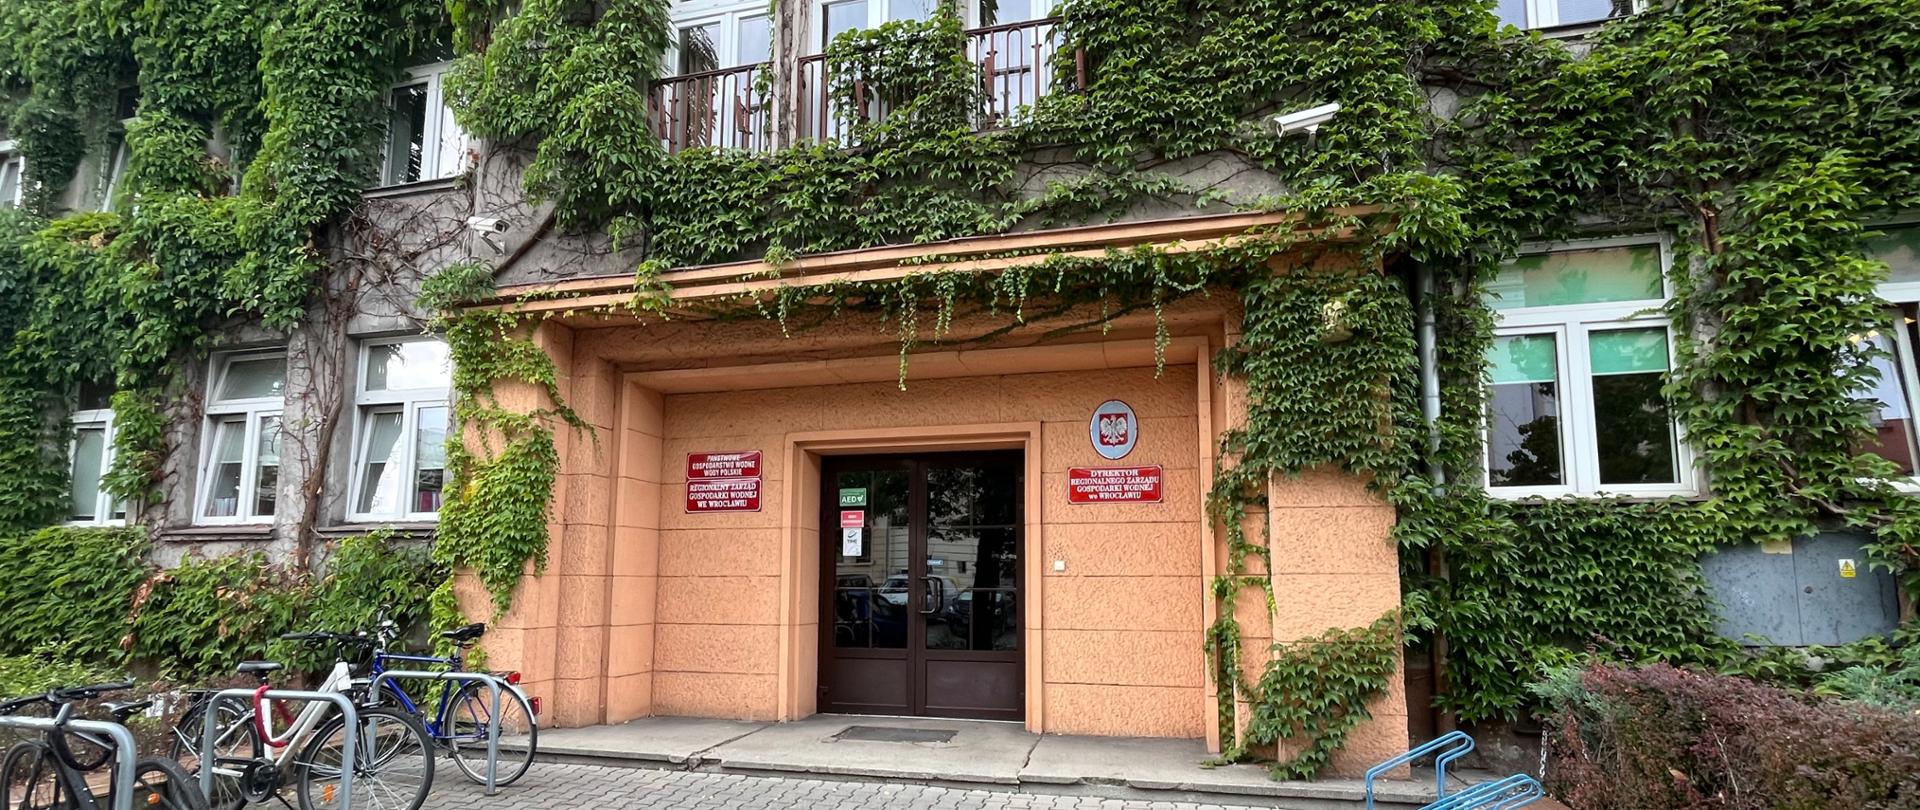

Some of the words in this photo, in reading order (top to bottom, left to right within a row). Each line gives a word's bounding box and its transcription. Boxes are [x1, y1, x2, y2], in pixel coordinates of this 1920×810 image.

[692, 462, 734, 470] GOSPODARSTWO
[720, 468, 742, 476] POLSKIE
[1071, 477, 1125, 485] REGIONALNEGO
[689, 484, 729, 492] REGIONALNY
[1123, 483, 1153, 491] WODNEJ
[689, 491, 729, 500] GOSPODARKI
[730, 490, 757, 499] WODNEJ
[697, 500, 707, 508] WE
